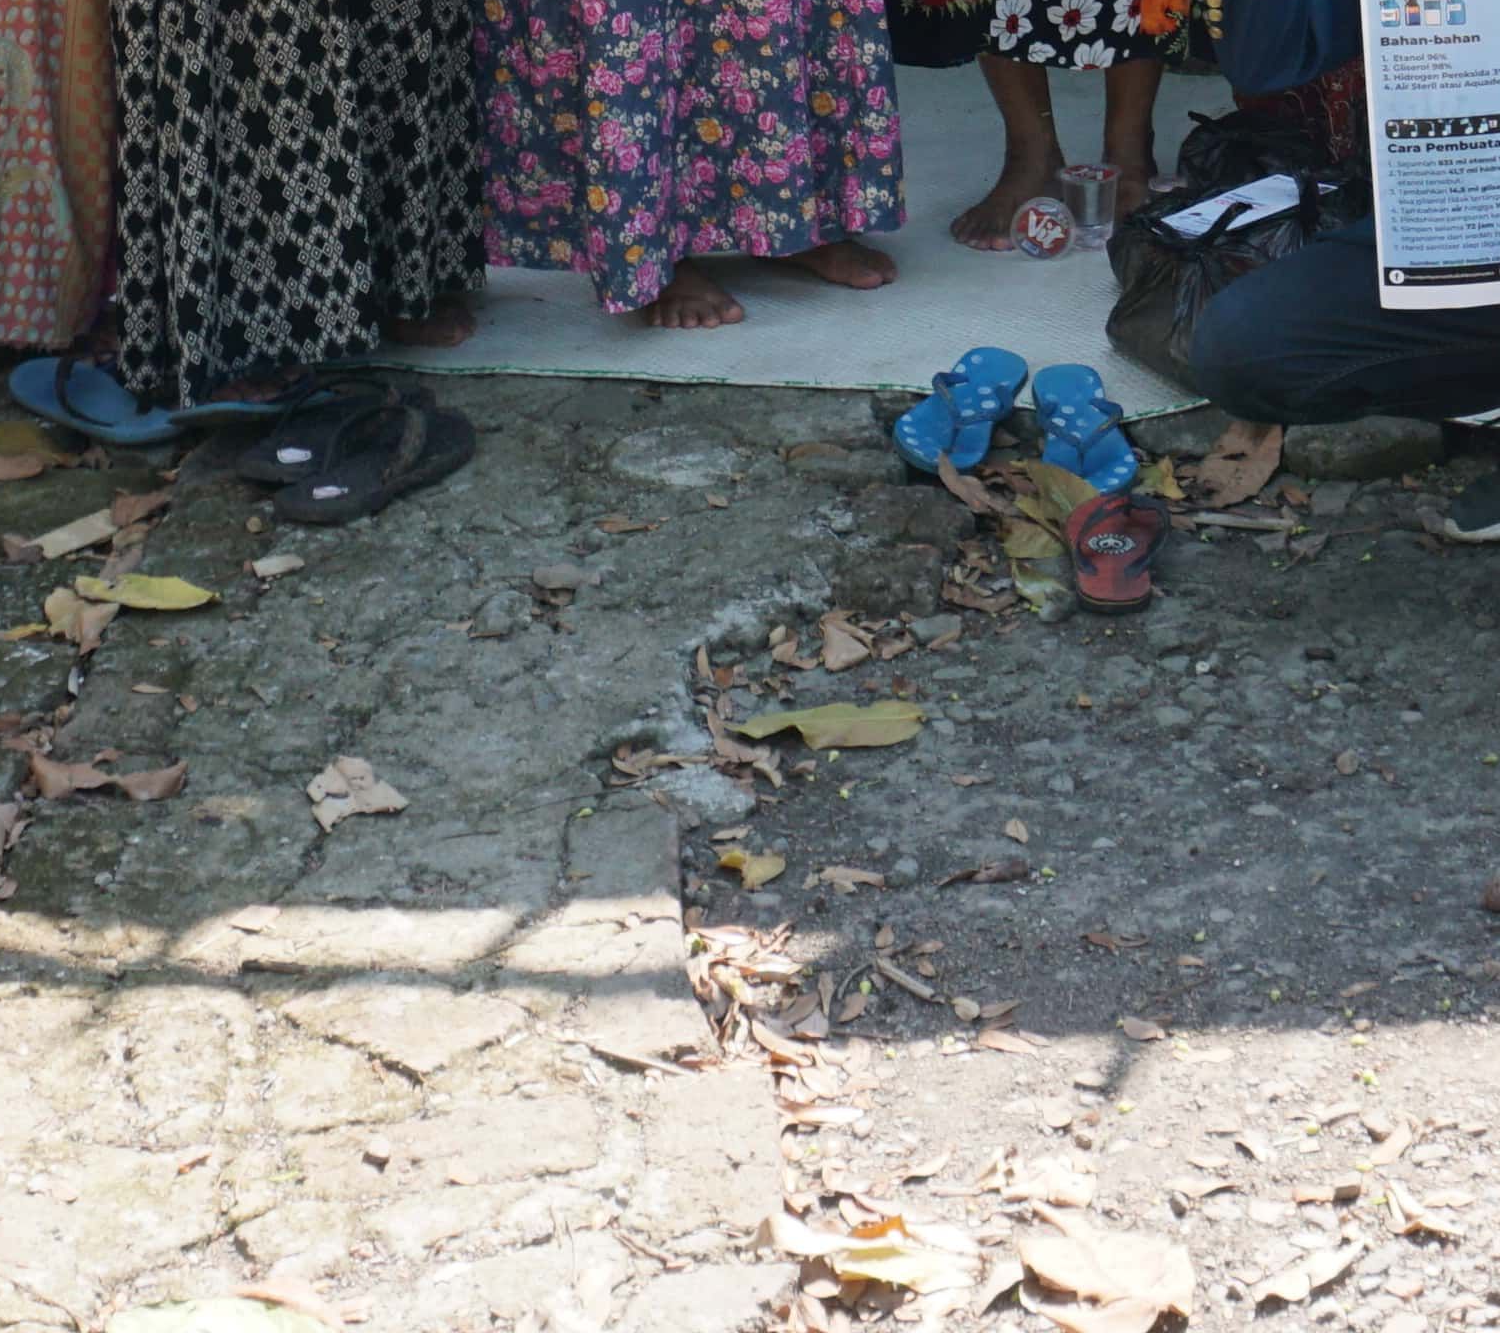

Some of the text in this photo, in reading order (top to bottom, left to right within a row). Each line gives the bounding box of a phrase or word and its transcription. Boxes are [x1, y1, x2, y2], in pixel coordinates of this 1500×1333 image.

[1380, 34, 1481, 47] Bahan-bahan
[1393, 53, 1424, 62] Etanol
[1427, 53, 1448, 61] 96%
[1393, 63, 1430, 72] Gliserol
[1394, 73, 1439, 83] Hidrogen
[1442, 69, 1490, 79] Peroksida
[1395, 82, 1408, 91] Air
[1411, 81, 1437, 91] Steril
[1439, 81, 1461, 90] atau
[1388, 143, 1421, 153] Cara
[1478, 221, 1495, 231] jam
